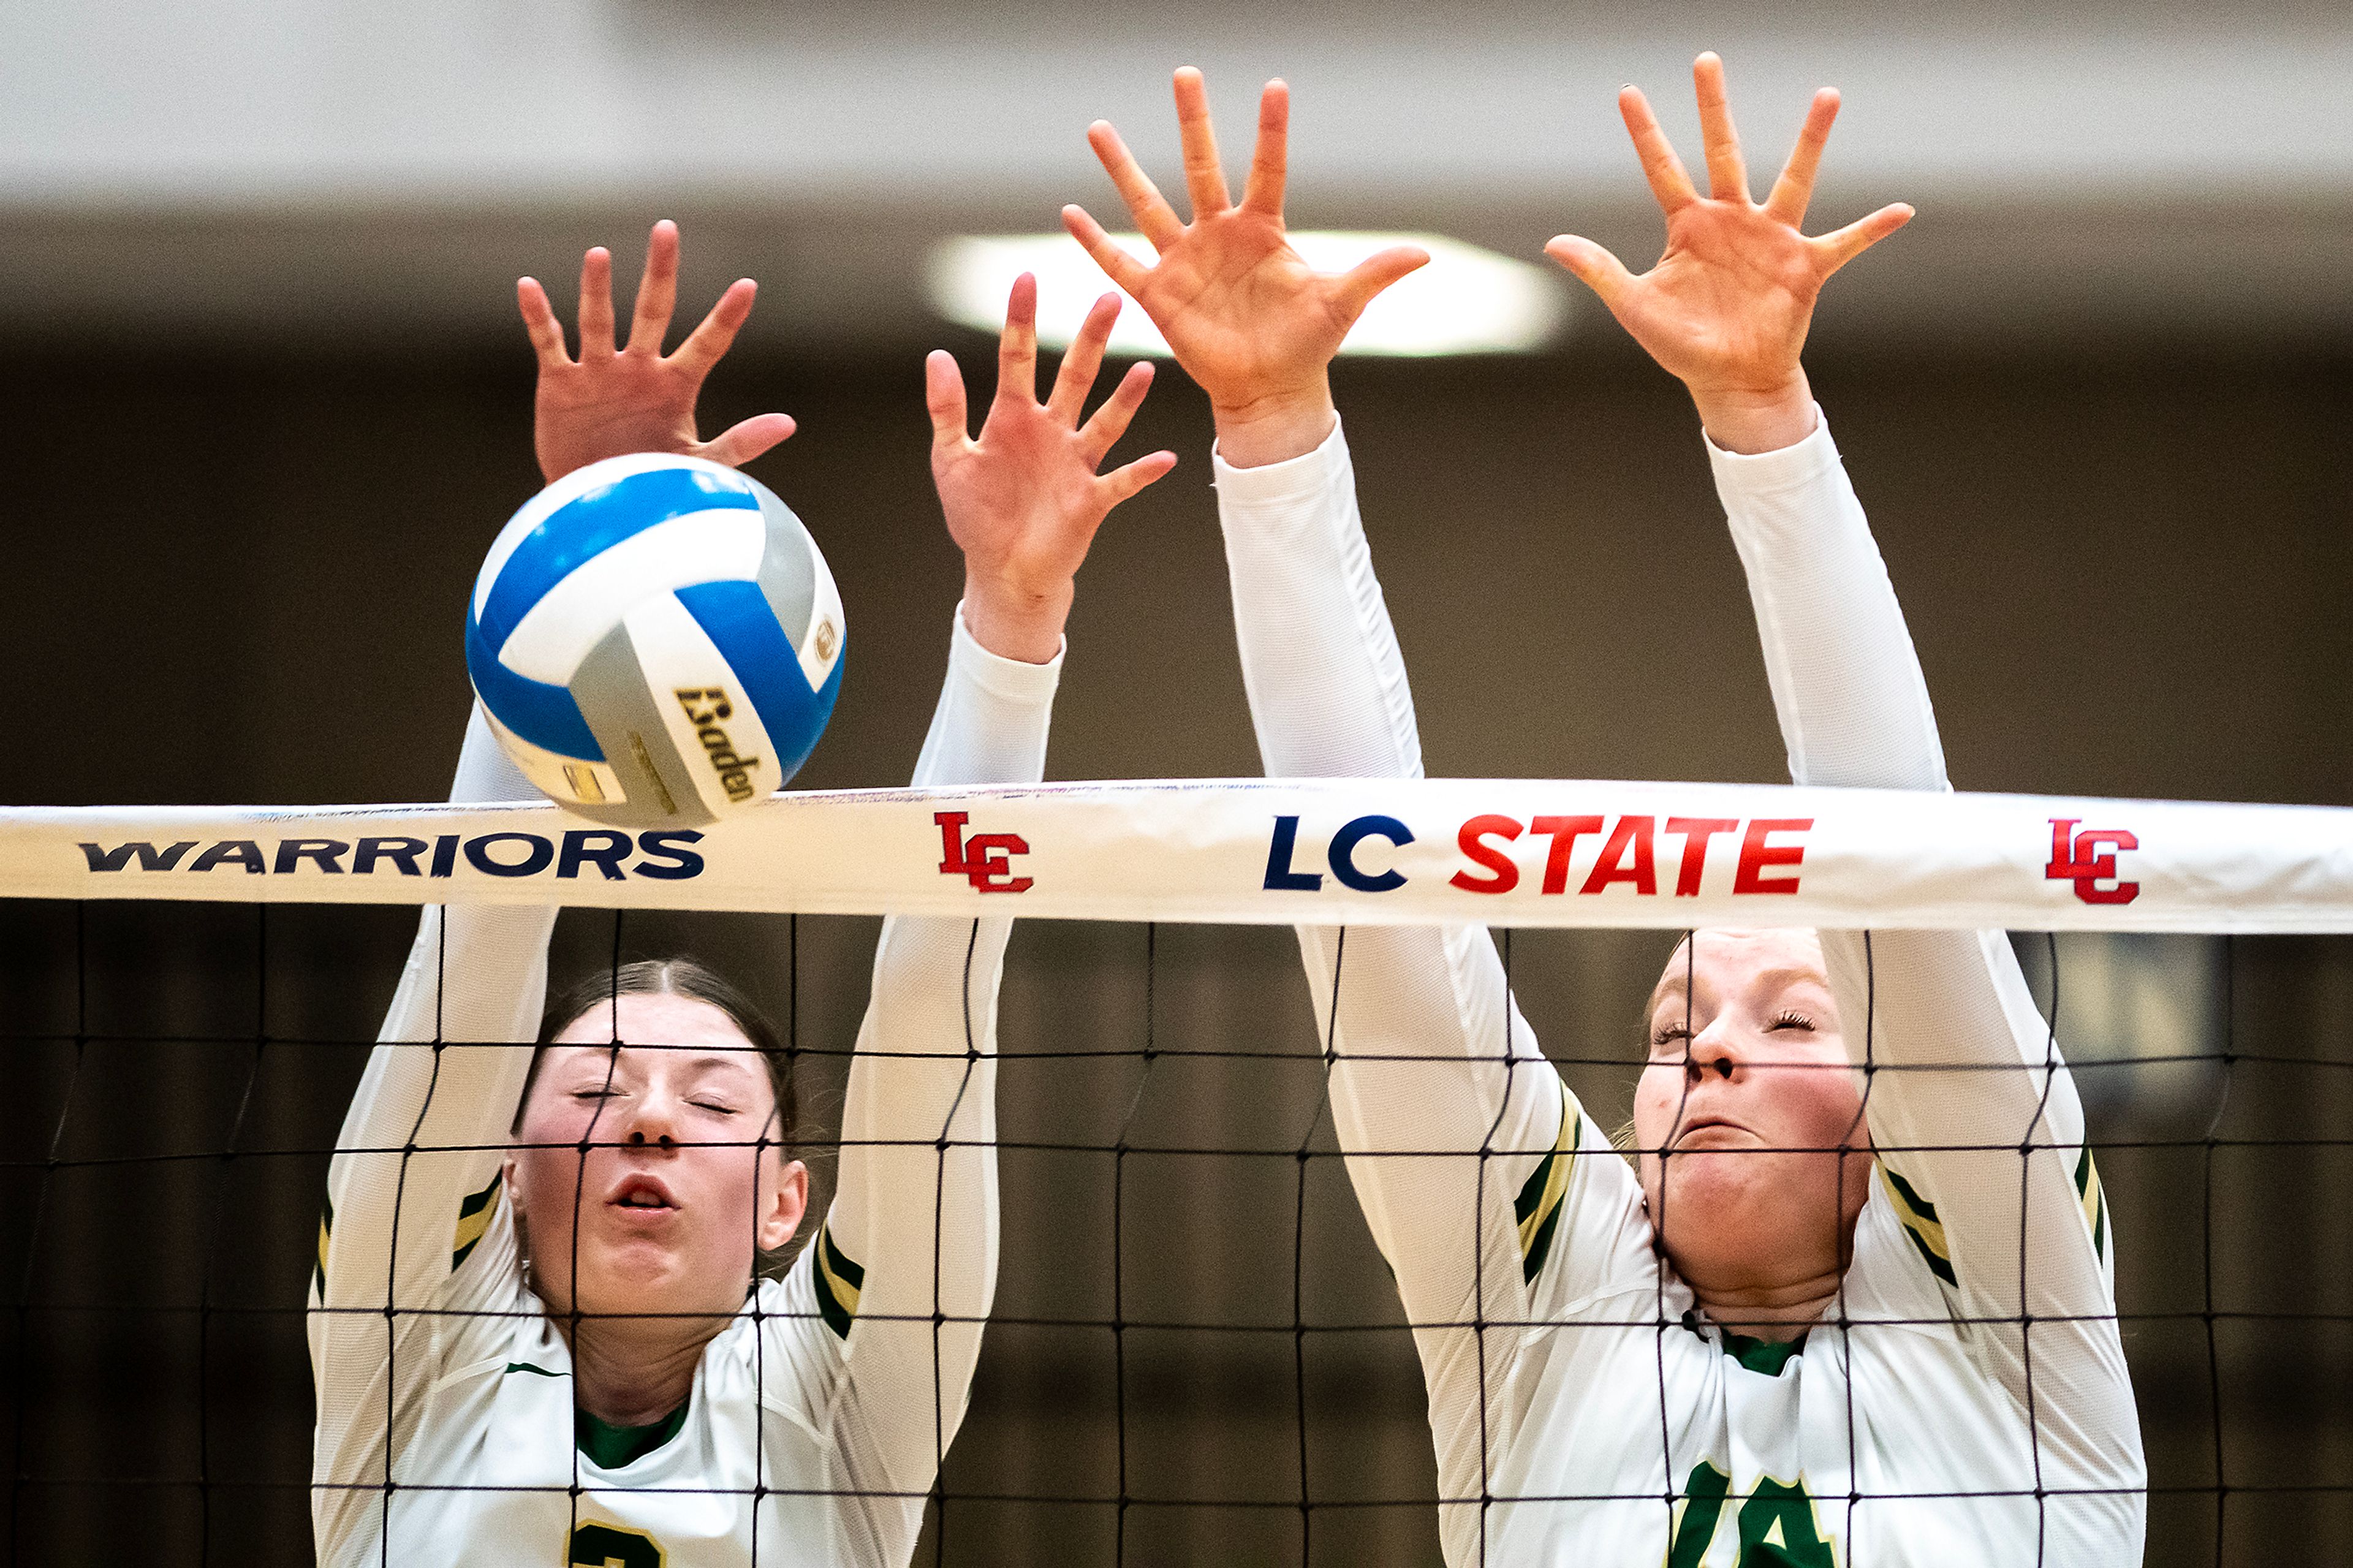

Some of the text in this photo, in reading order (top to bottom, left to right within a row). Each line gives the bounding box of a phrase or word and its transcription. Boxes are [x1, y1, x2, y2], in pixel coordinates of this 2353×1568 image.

[673, 687, 760, 803] Baden
[76, 828, 705, 881] WARRIORS
[1262, 814, 1814, 896] LC STATE
